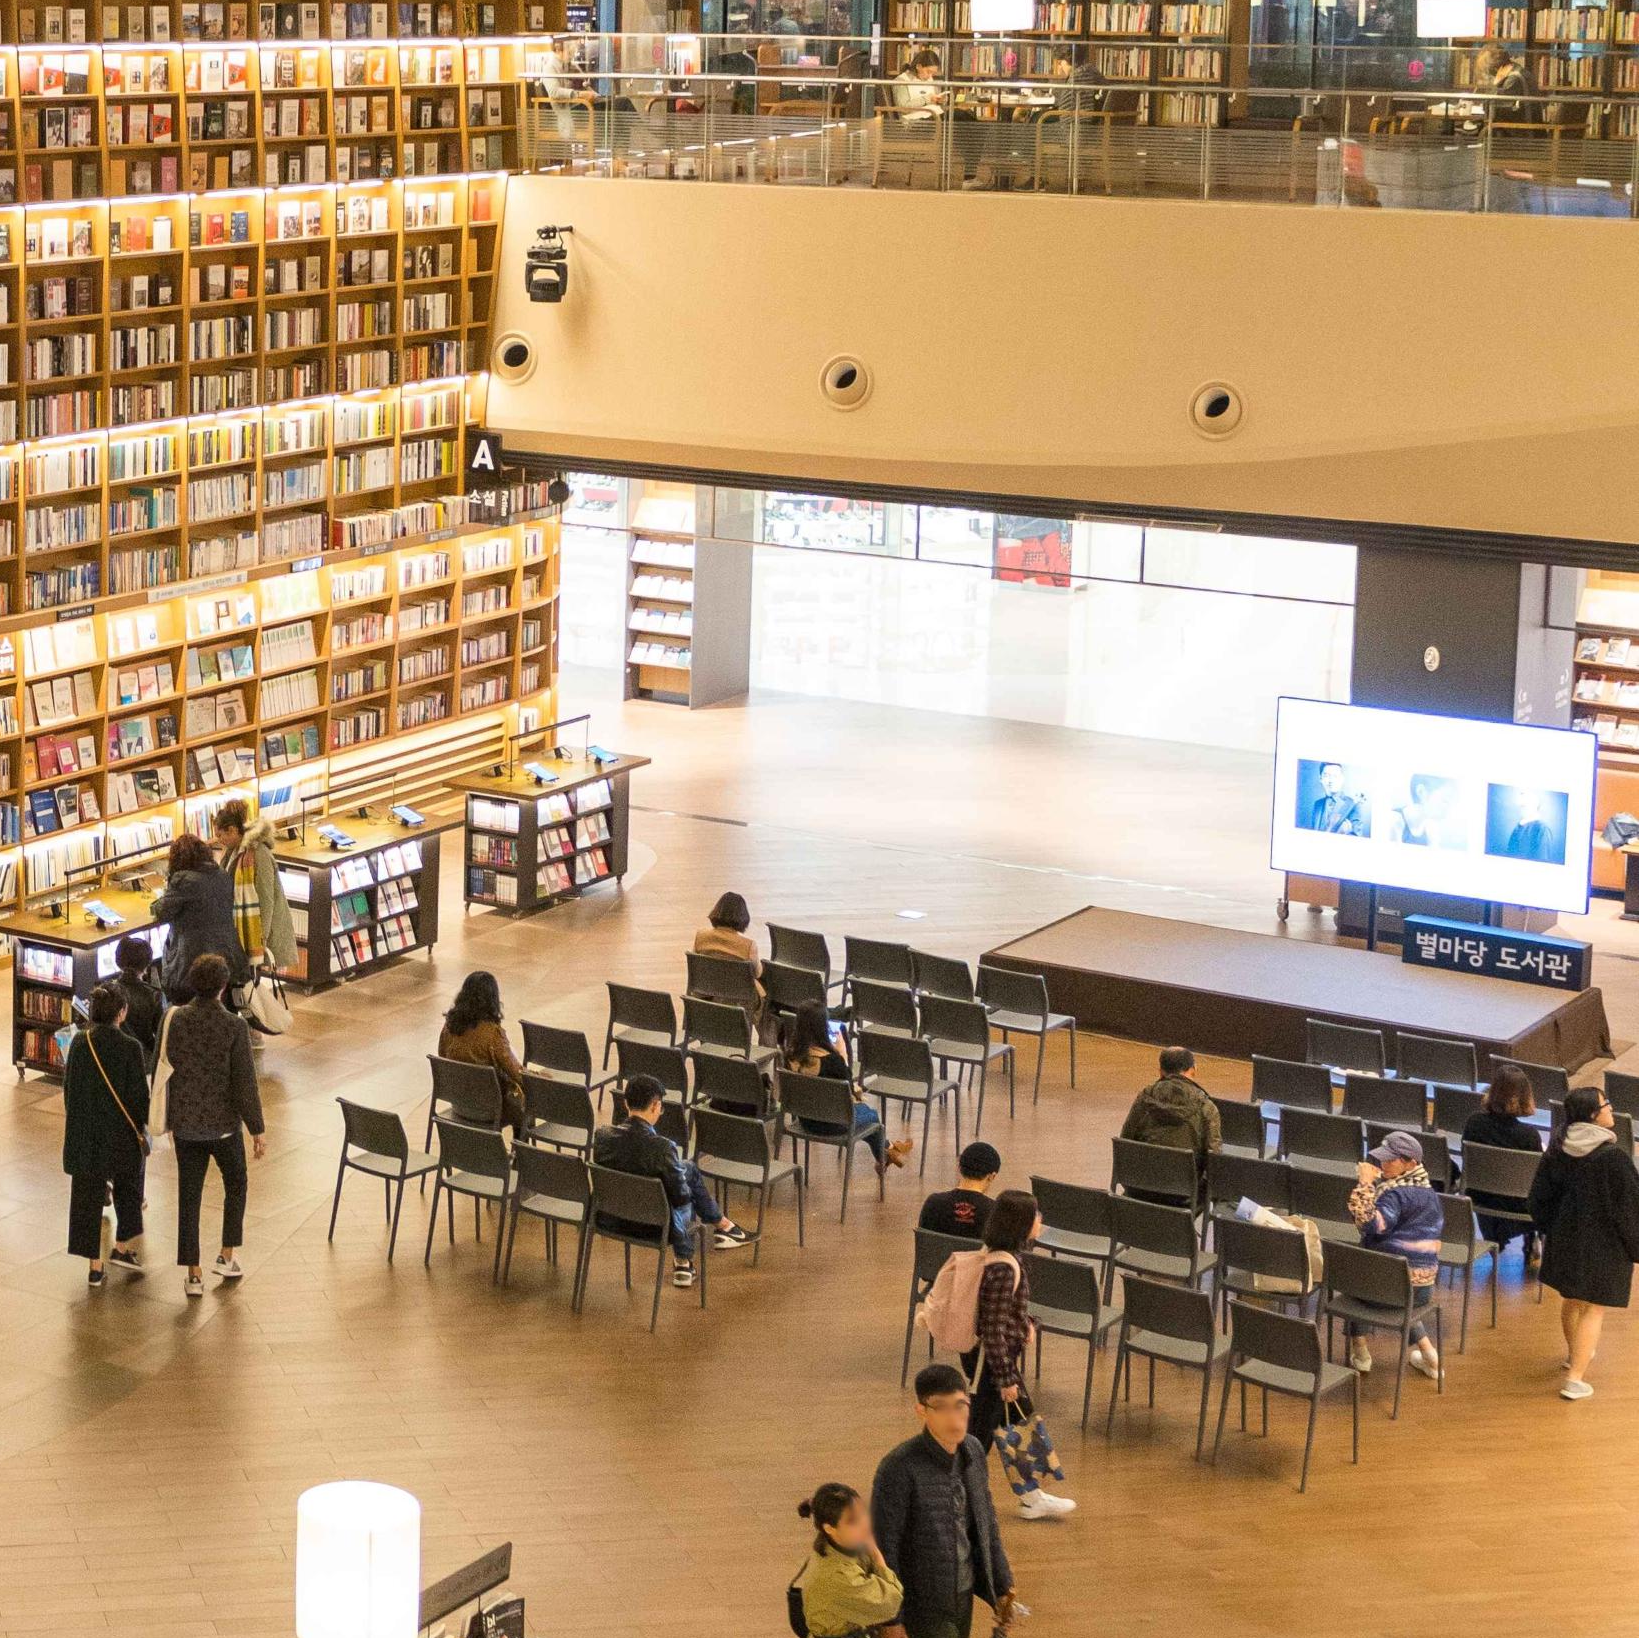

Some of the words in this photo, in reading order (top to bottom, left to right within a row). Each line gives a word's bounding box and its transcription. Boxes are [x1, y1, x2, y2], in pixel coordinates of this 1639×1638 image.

[472, 439, 495, 470] A
[469, 489, 496, 507] 소설
[1416, 931, 1487, 968] 별마당
[1496, 946, 1572, 981] 도서관
